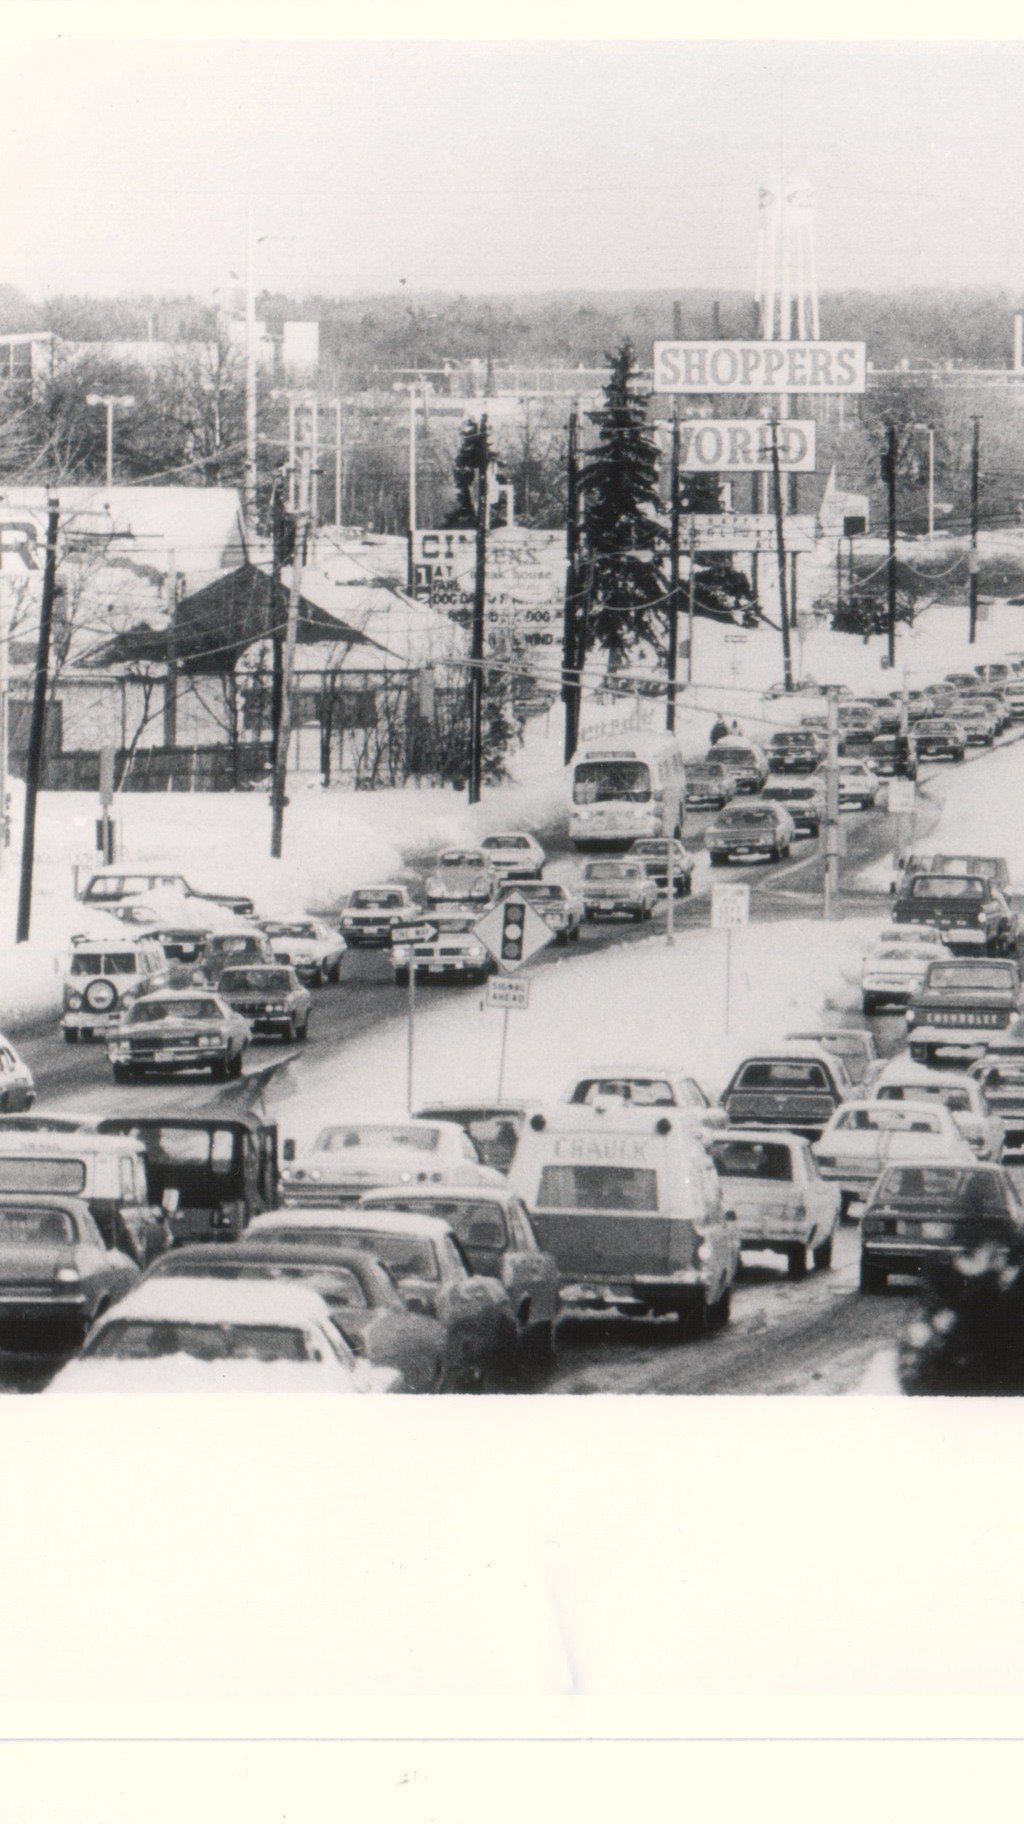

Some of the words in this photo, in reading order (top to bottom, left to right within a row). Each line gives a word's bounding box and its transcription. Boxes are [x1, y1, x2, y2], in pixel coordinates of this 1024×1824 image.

[659, 347, 858, 387] SHOPPERS
[432, 592, 458, 605] DOG
[492, 993, 525, 1002] AHEAD
[926, 1012, 998, 1025] CHEVROLET
